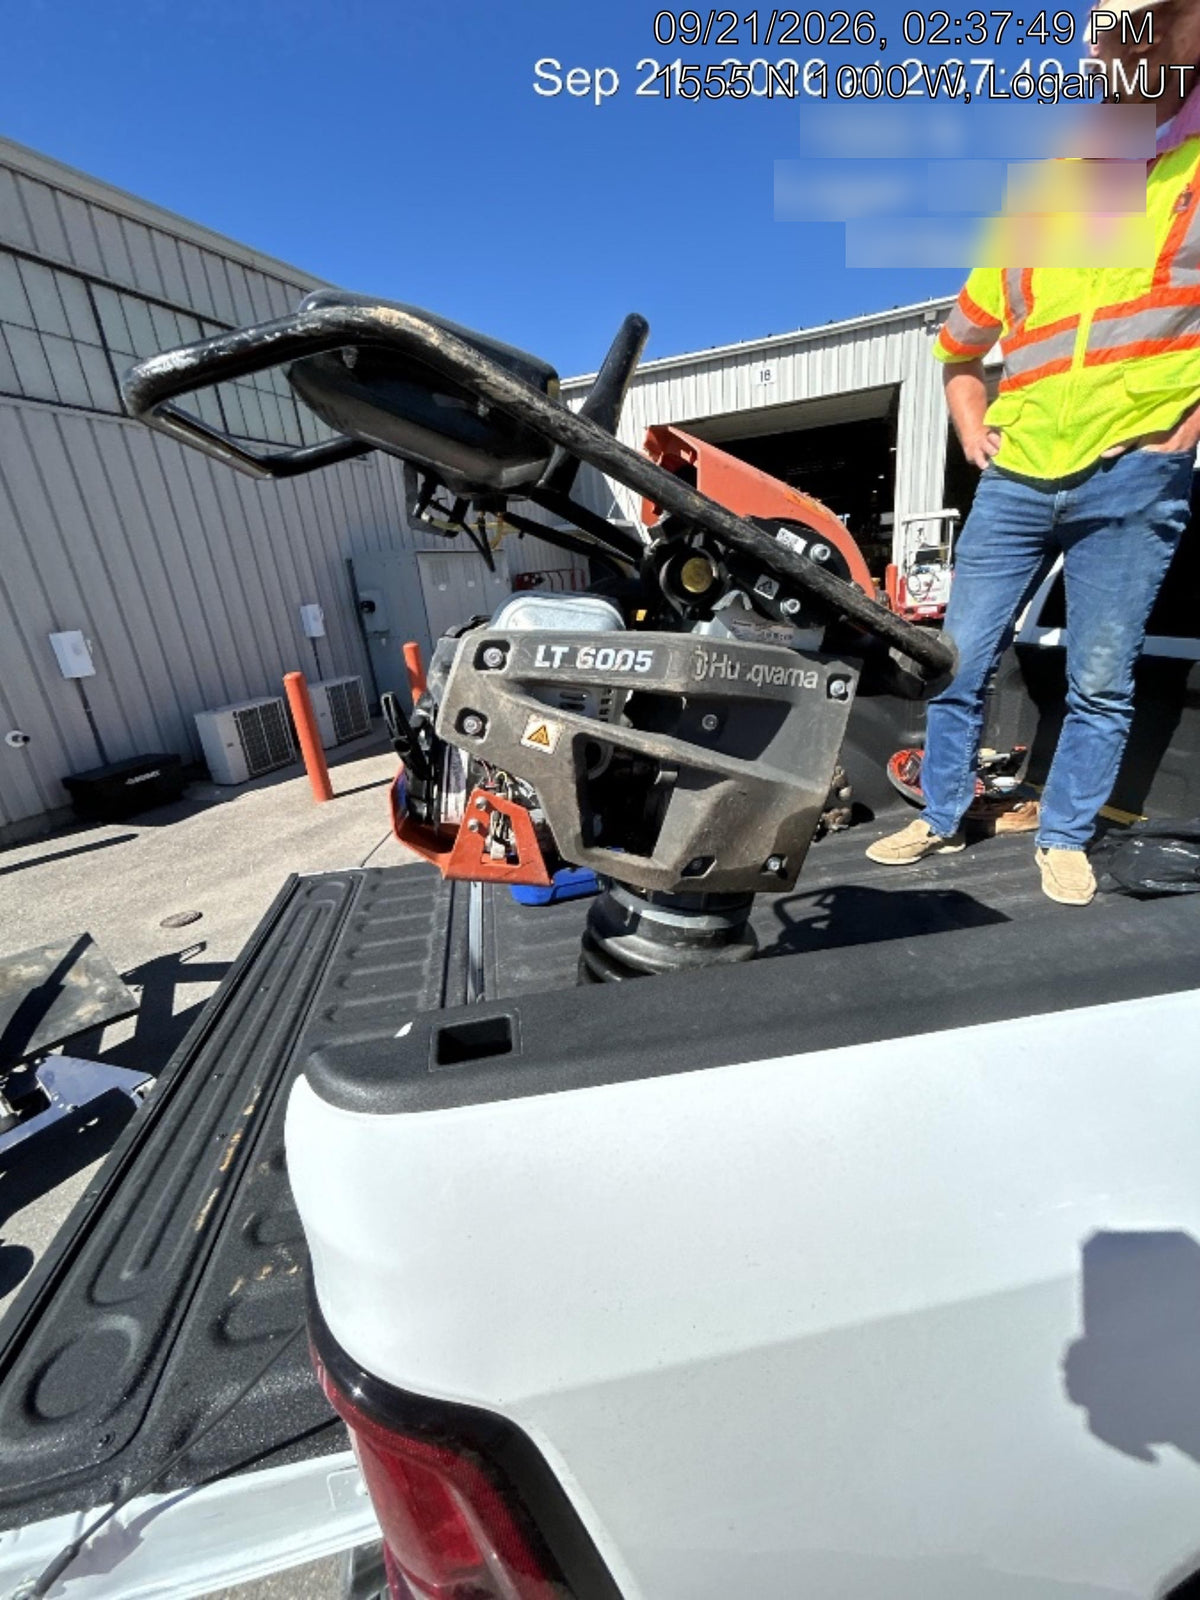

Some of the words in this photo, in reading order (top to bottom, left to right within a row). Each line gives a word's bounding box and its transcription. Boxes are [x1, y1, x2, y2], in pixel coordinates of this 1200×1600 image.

[534, 644, 570, 669] LT
[575, 646, 653, 673] 6005
[708, 651, 819, 689] Huqvarna
